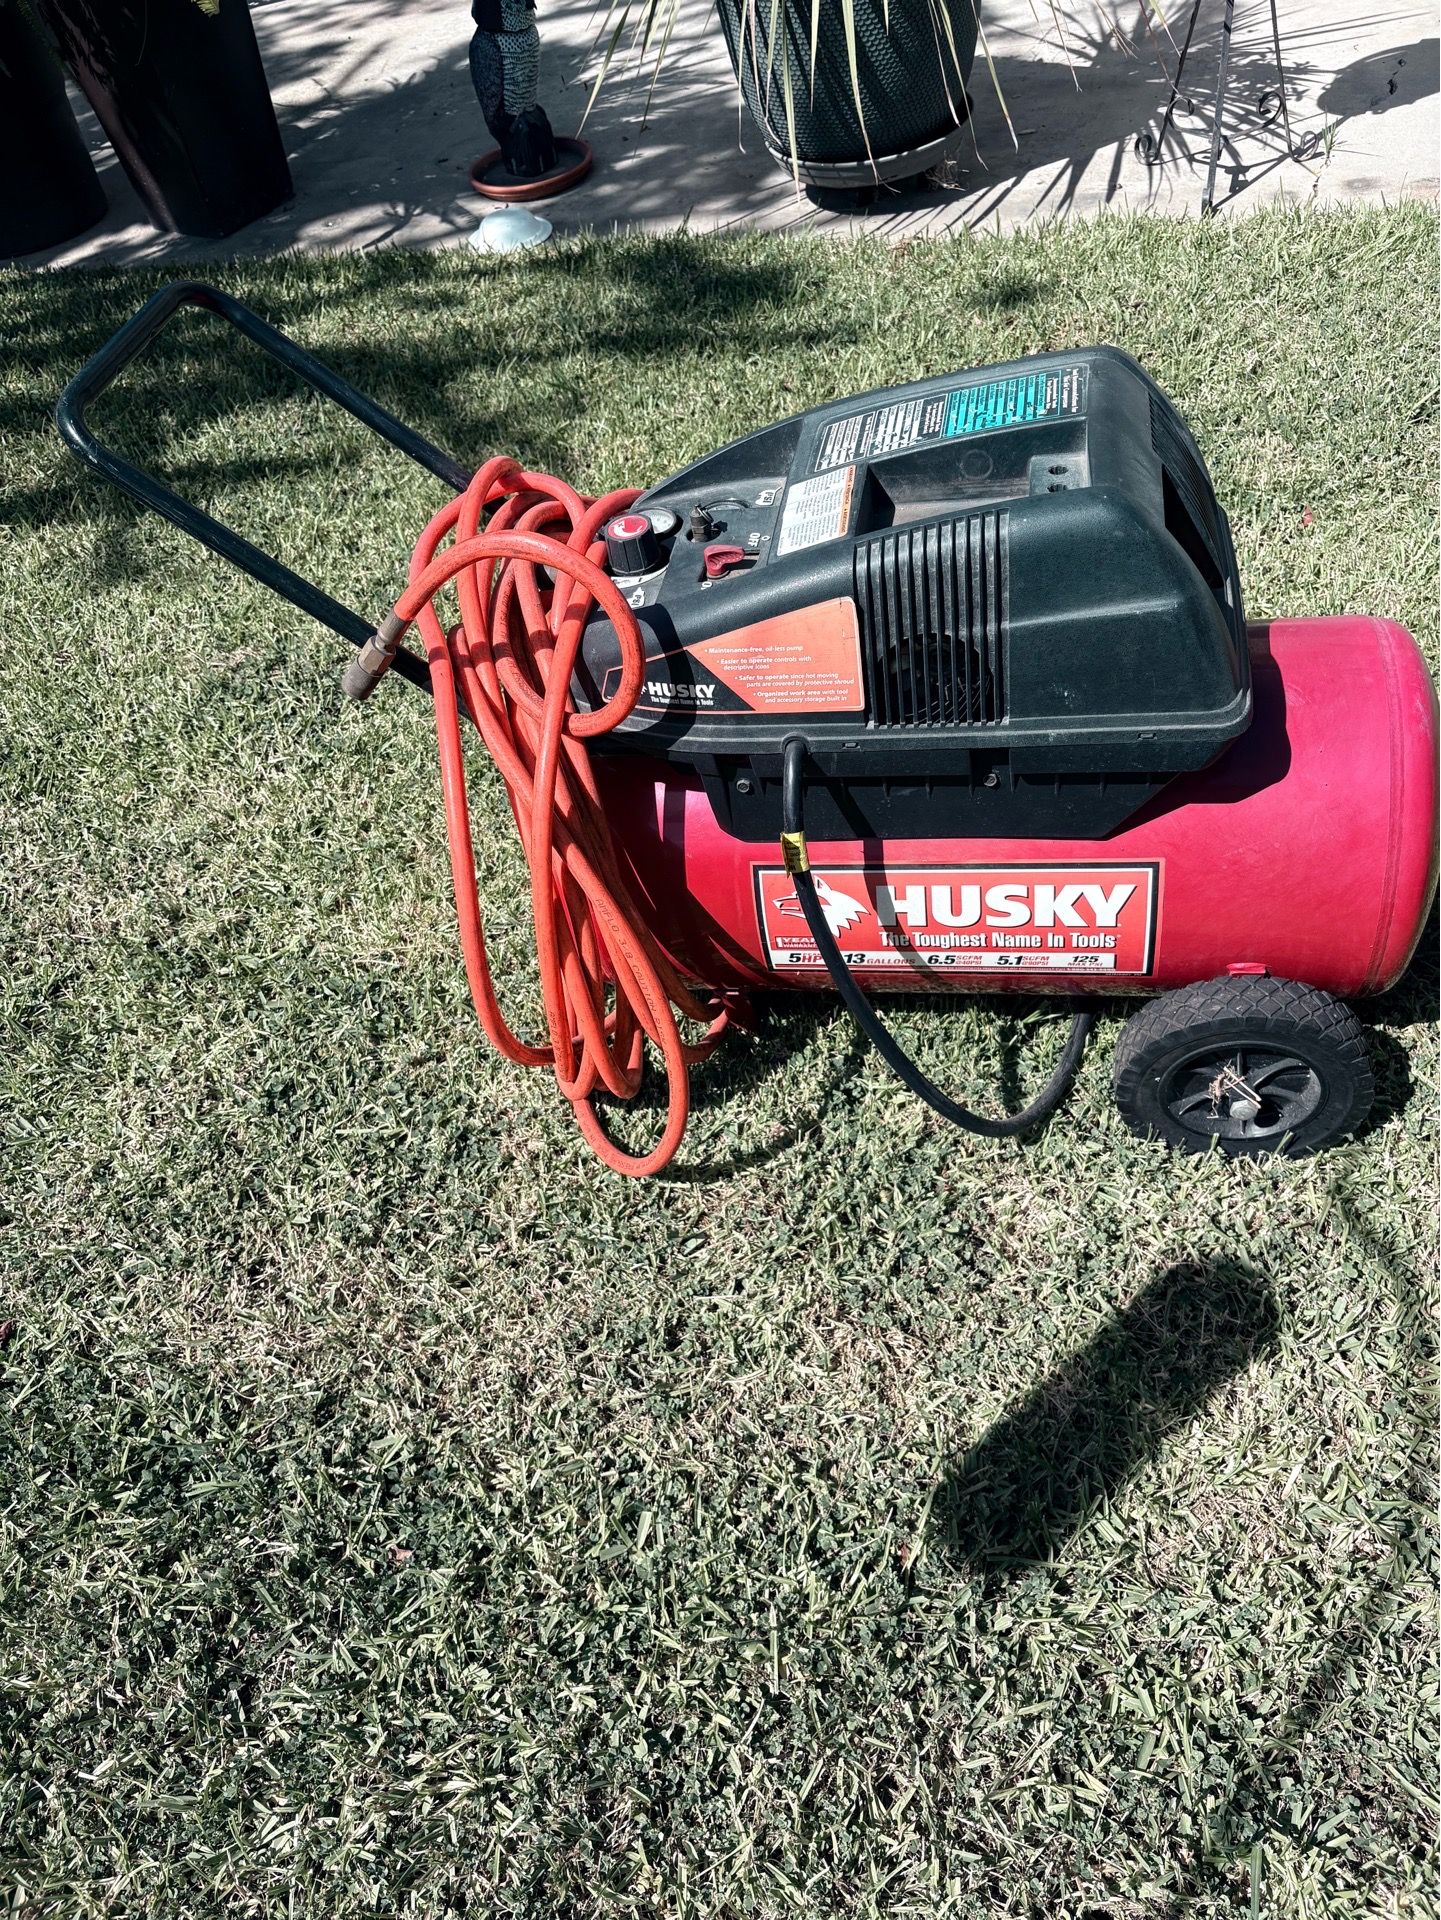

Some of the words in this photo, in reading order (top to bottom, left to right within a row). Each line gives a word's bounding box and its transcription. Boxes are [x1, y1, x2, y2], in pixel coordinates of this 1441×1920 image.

[748, 532, 760, 547] OFF
[786, 645, 804, 653] pump
[748, 657, 773, 665] operate
[647, 682, 715, 698] HUSKY
[746, 681, 761, 689] parts
[757, 690, 788, 698] Organized
[876, 884, 1137, 928] HUSKY
[878, 931, 909, 947] The
[912, 931, 986, 949] Toughest
[992, 932, 1041, 948] Name
[1047, 932, 1064, 948] In
[1069, 932, 1116, 948] Tools
[789, 953, 801, 963] 5
[802, 955, 823, 963] HP
[844, 953, 866, 964] 13
[927, 954, 956, 965] 6.5
[996, 955, 1023, 966] 5.1
[1072, 955, 1100, 963] 125
